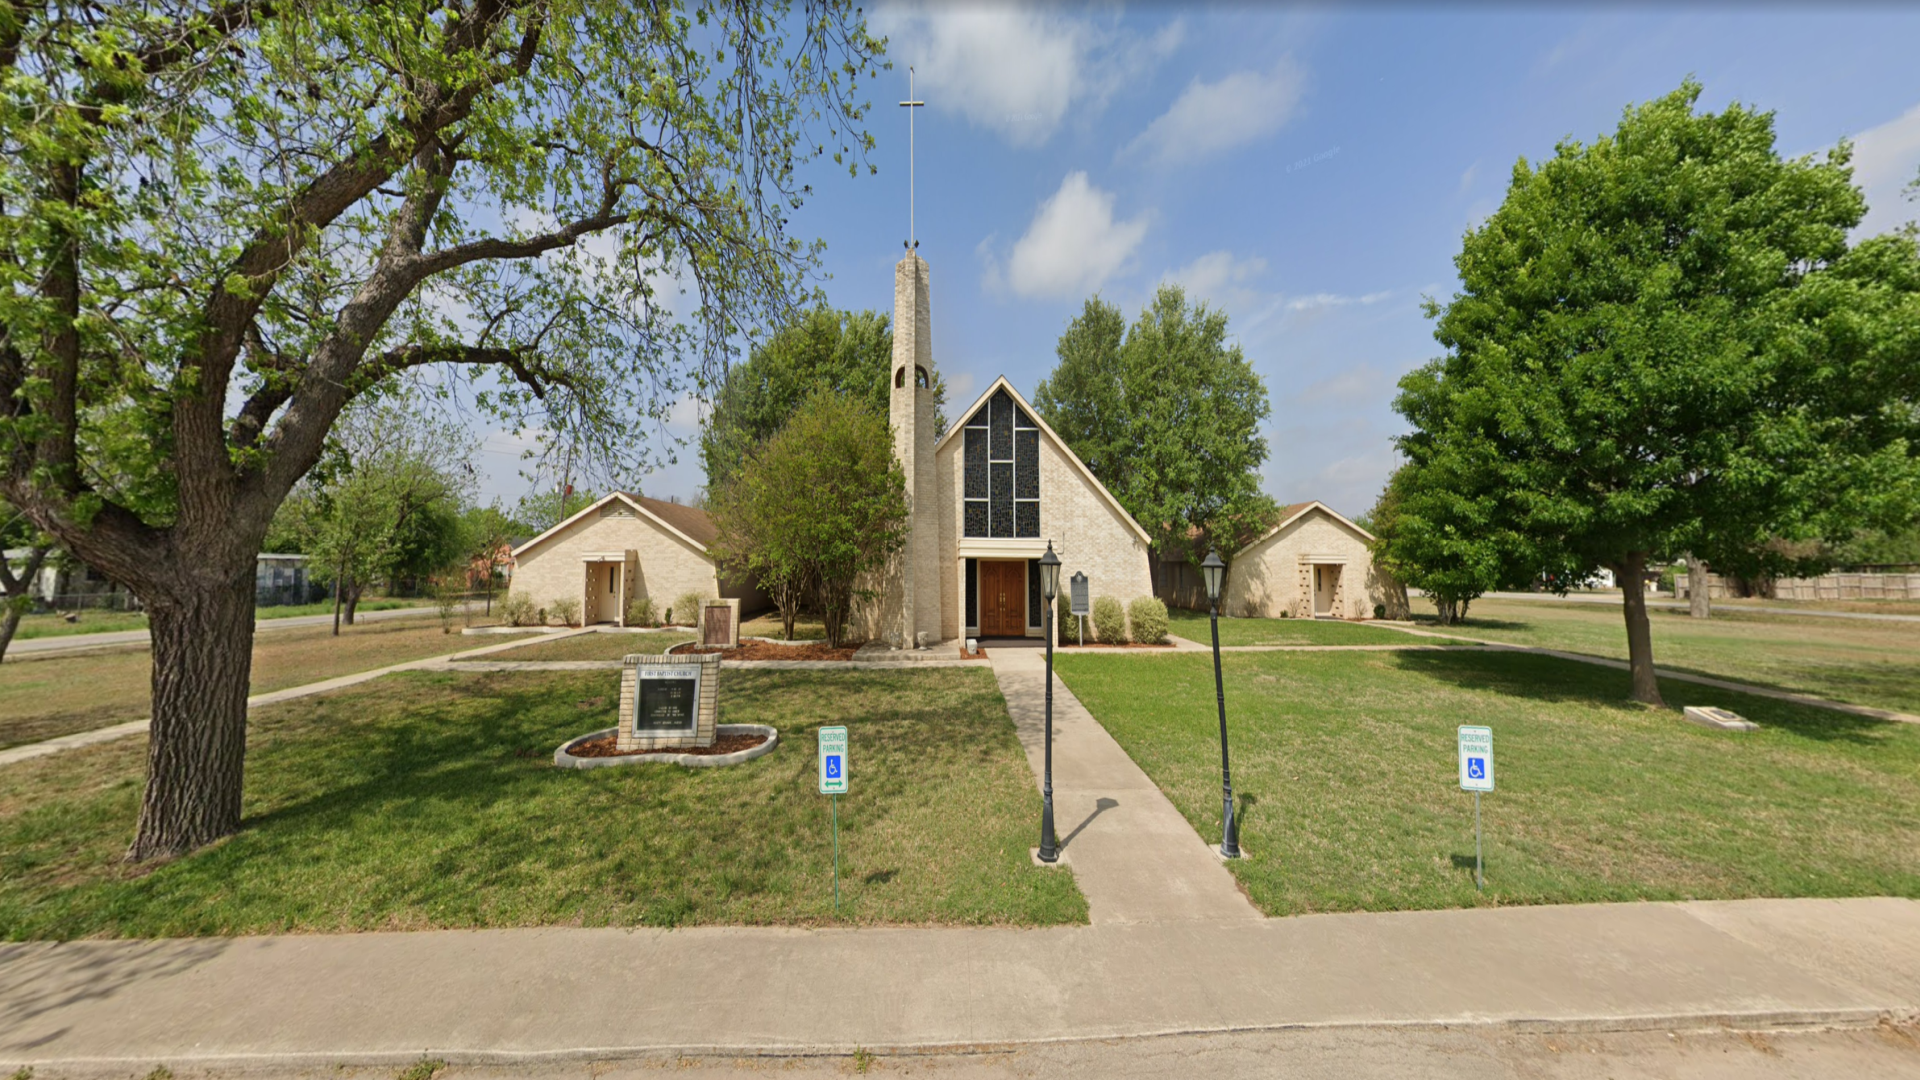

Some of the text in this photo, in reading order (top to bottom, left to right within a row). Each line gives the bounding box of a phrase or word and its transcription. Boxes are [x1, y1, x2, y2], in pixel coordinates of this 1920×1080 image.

[821, 733, 845, 742] RESERVED
[1461, 734, 1489, 743] RESERVED
[823, 744, 844, 753] PARKING
[1463, 744, 1488, 754] PARKING
